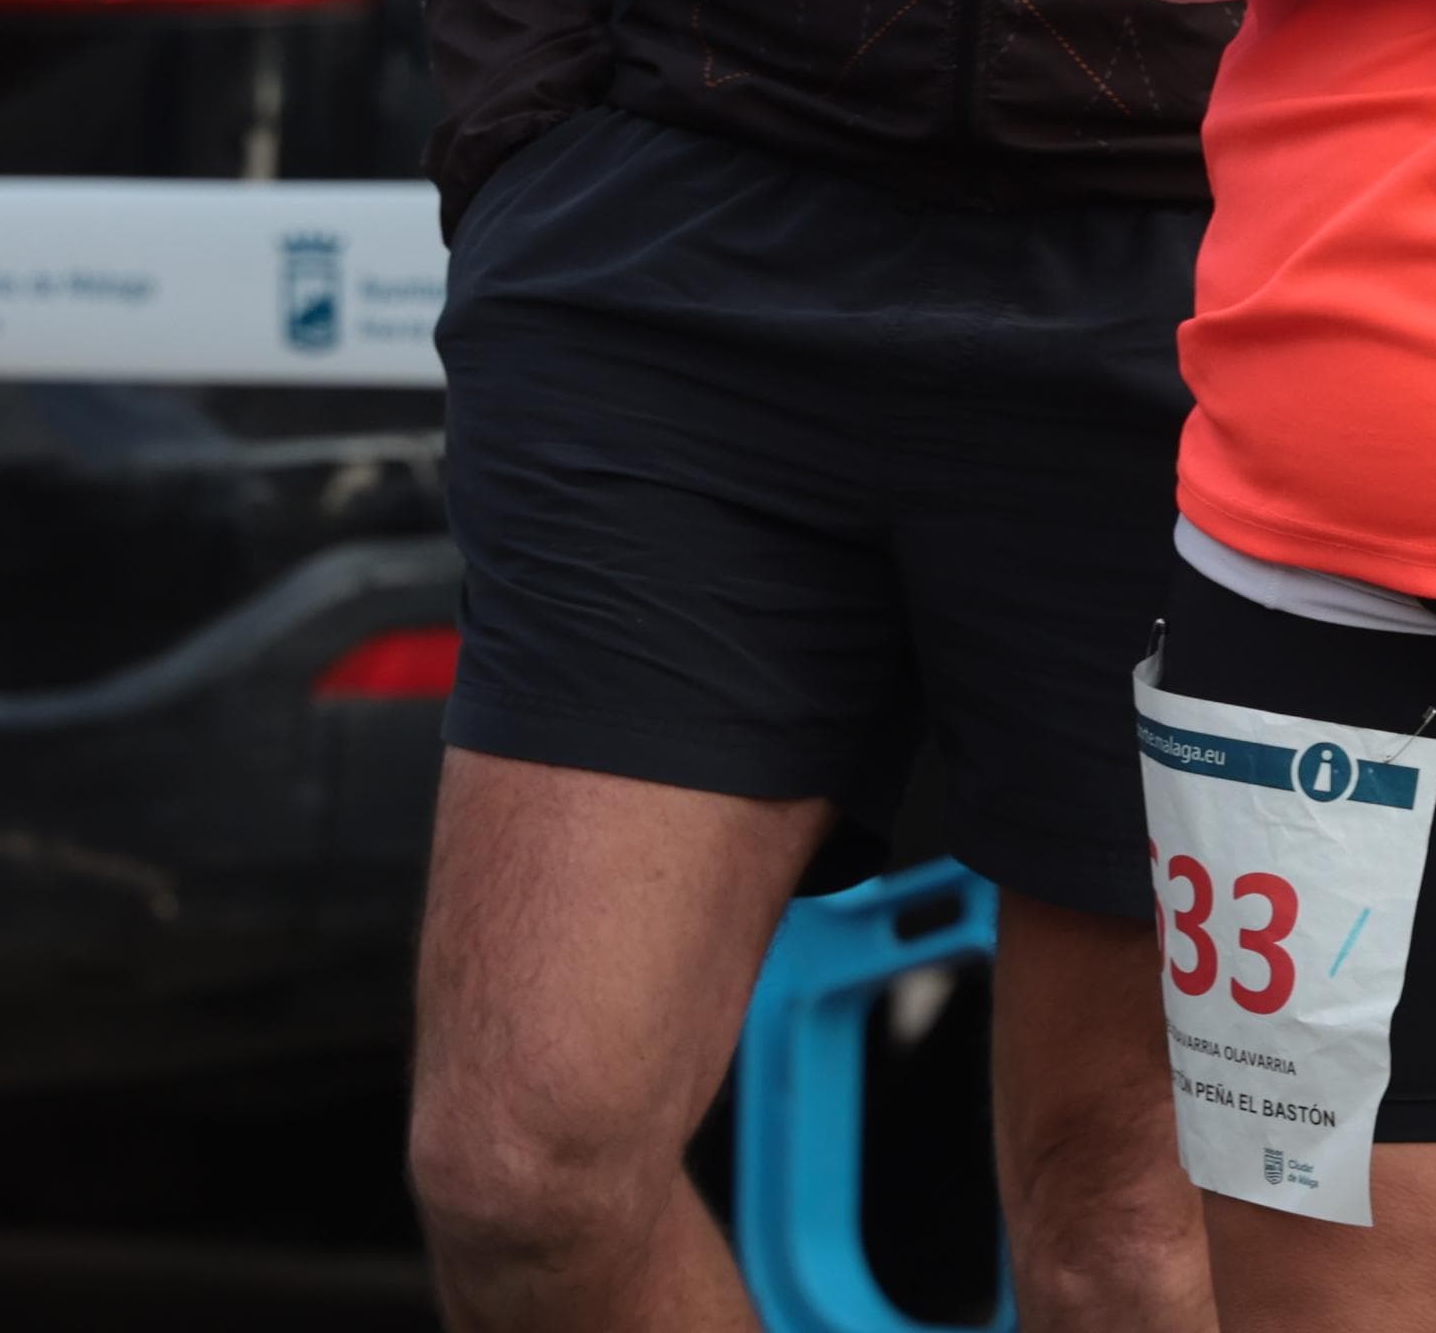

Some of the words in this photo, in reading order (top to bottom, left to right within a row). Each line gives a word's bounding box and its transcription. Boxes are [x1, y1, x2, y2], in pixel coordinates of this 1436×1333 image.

[1148, 837, 1299, 1015] 33
[1224, 1045, 1297, 1076] OLAVARRIA
[1195, 1082, 1235, 1109] PEÑA
[1238, 1093, 1258, 1115] EL
[1263, 1099, 1336, 1128] BASTÓN
